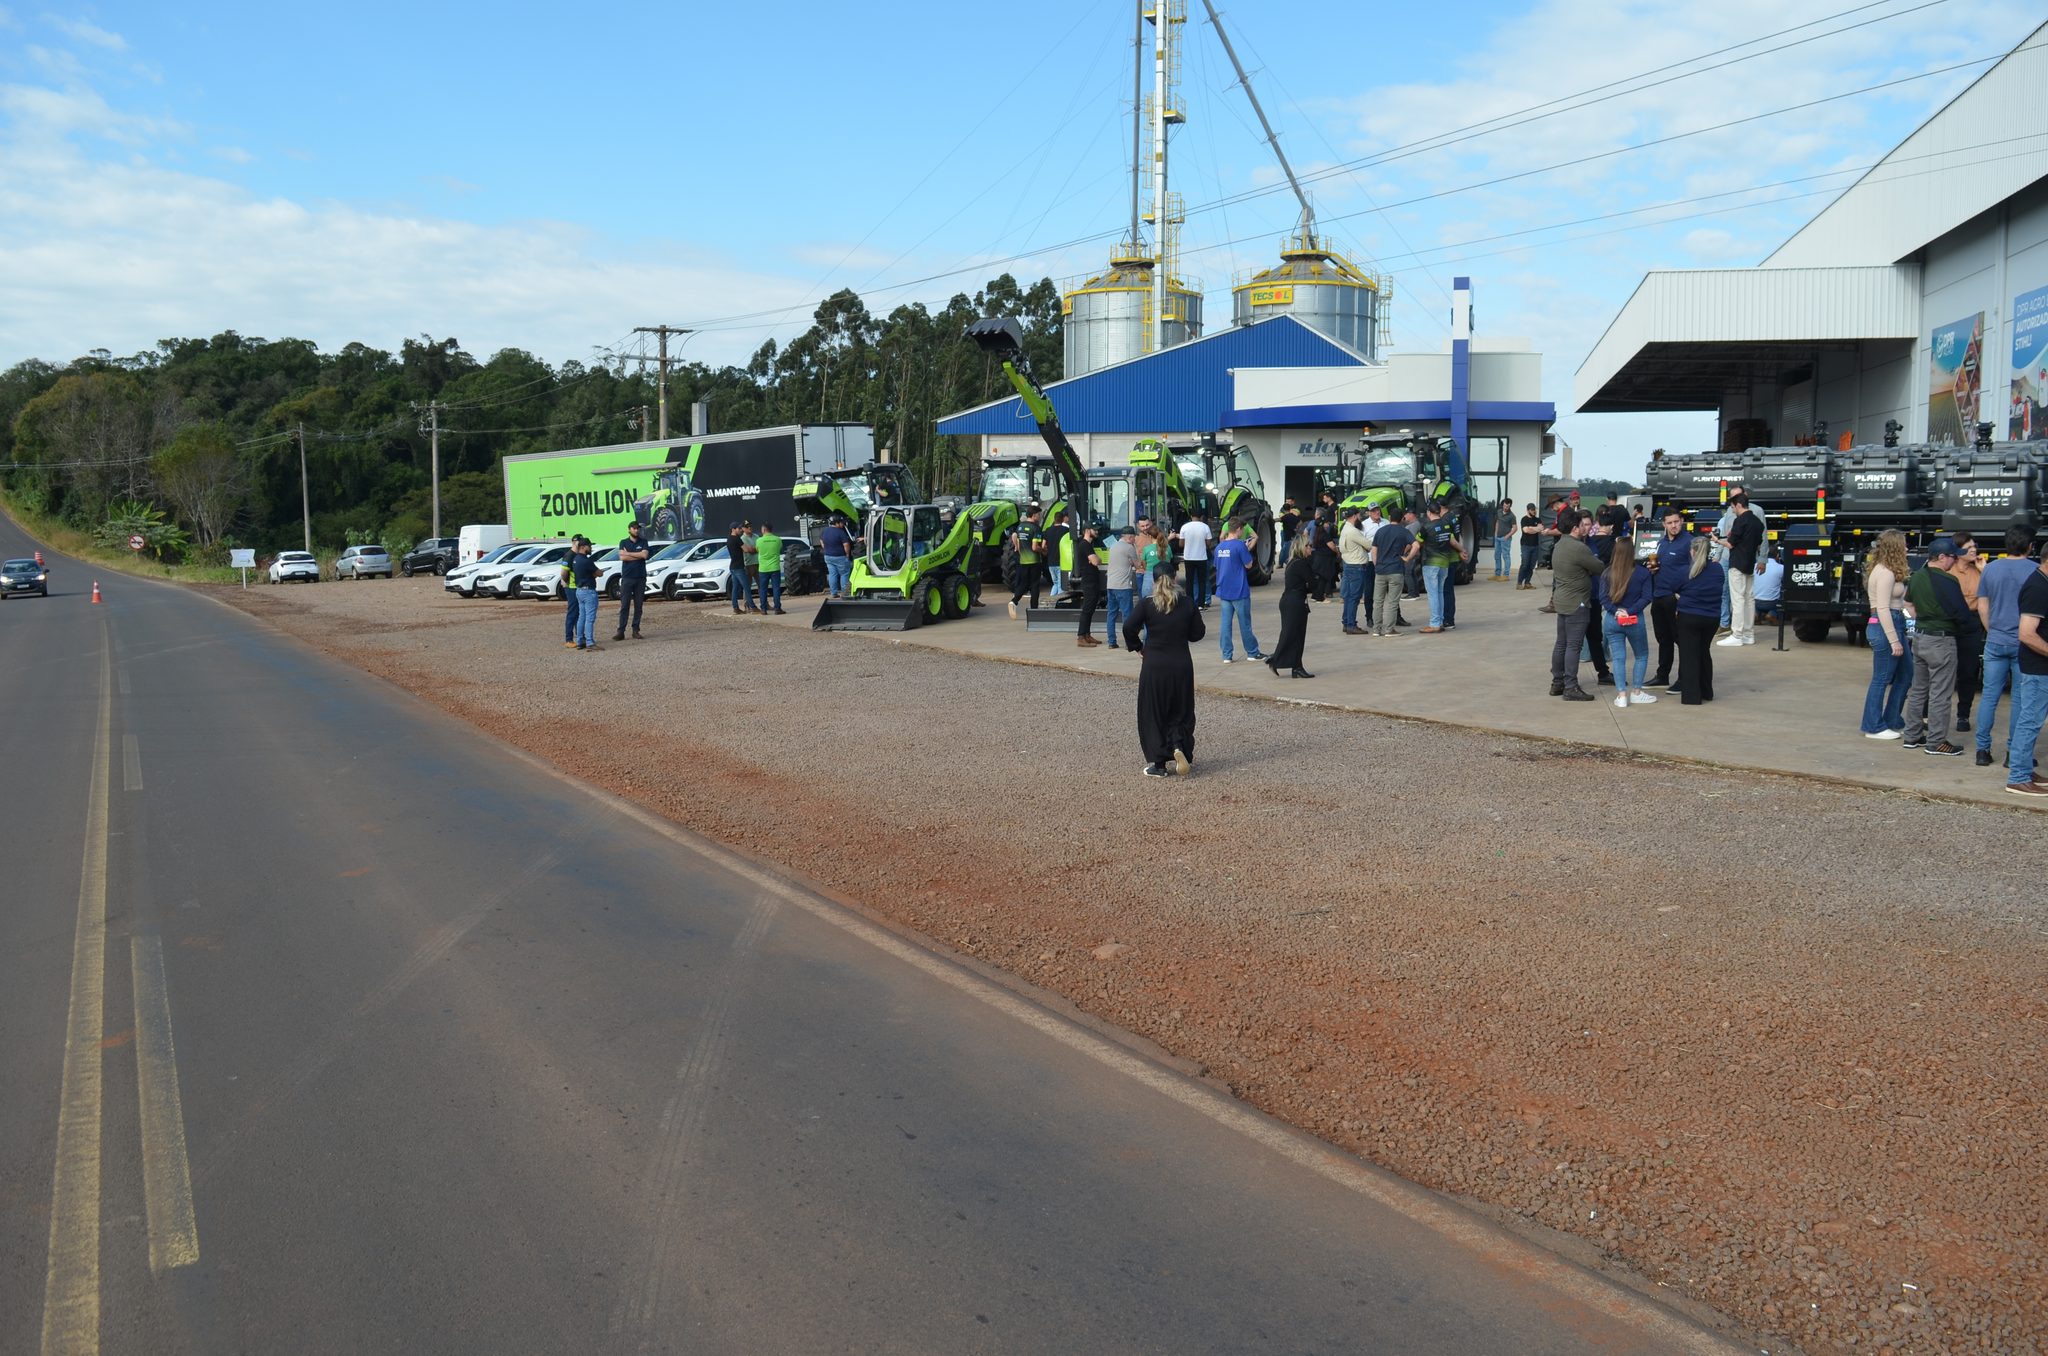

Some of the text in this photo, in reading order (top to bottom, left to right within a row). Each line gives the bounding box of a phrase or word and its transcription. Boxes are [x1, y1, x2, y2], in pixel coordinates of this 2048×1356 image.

[1857, 482, 1894, 490] DIRETO
[714, 485, 760, 497] MANTOMAC
[1959, 488, 2012, 497] PLANTIO
[541, 488, 637, 517] ZOOMLION
[1963, 498, 2010, 507] DIRETO
